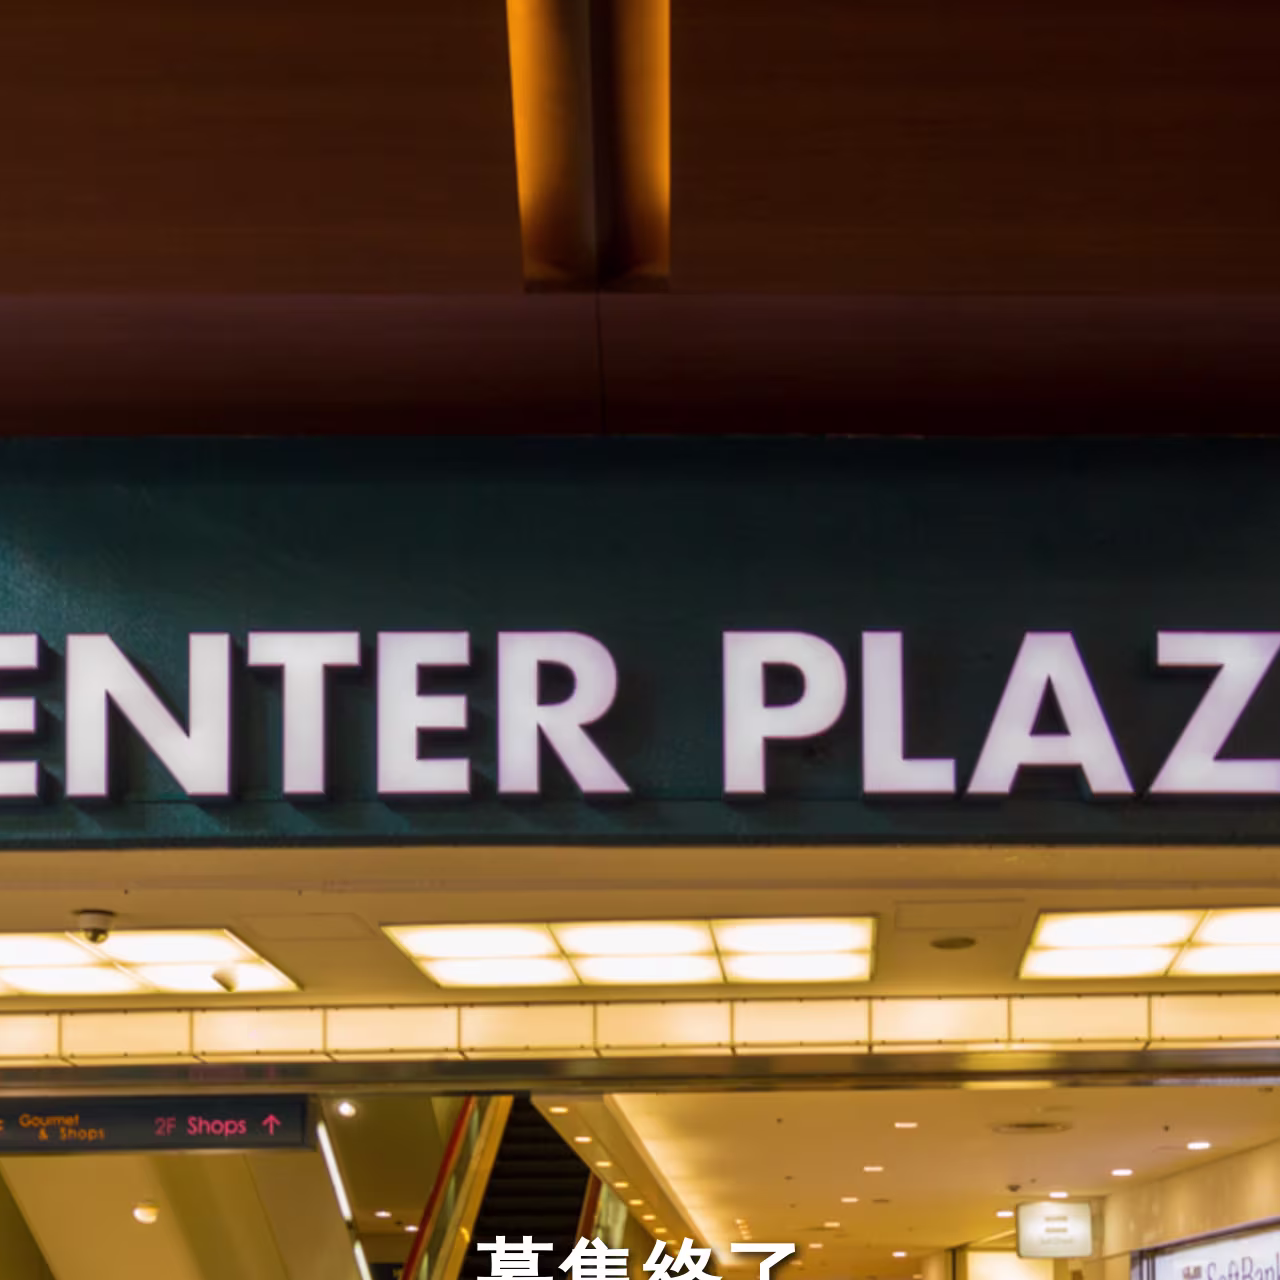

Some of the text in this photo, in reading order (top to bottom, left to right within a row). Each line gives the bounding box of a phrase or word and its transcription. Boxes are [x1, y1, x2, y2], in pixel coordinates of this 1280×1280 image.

[19, 1112, 80, 1128] Gourmet
[154, 1115, 247, 1137] 2F Shops
[60, 1127, 105, 1141] Shops
